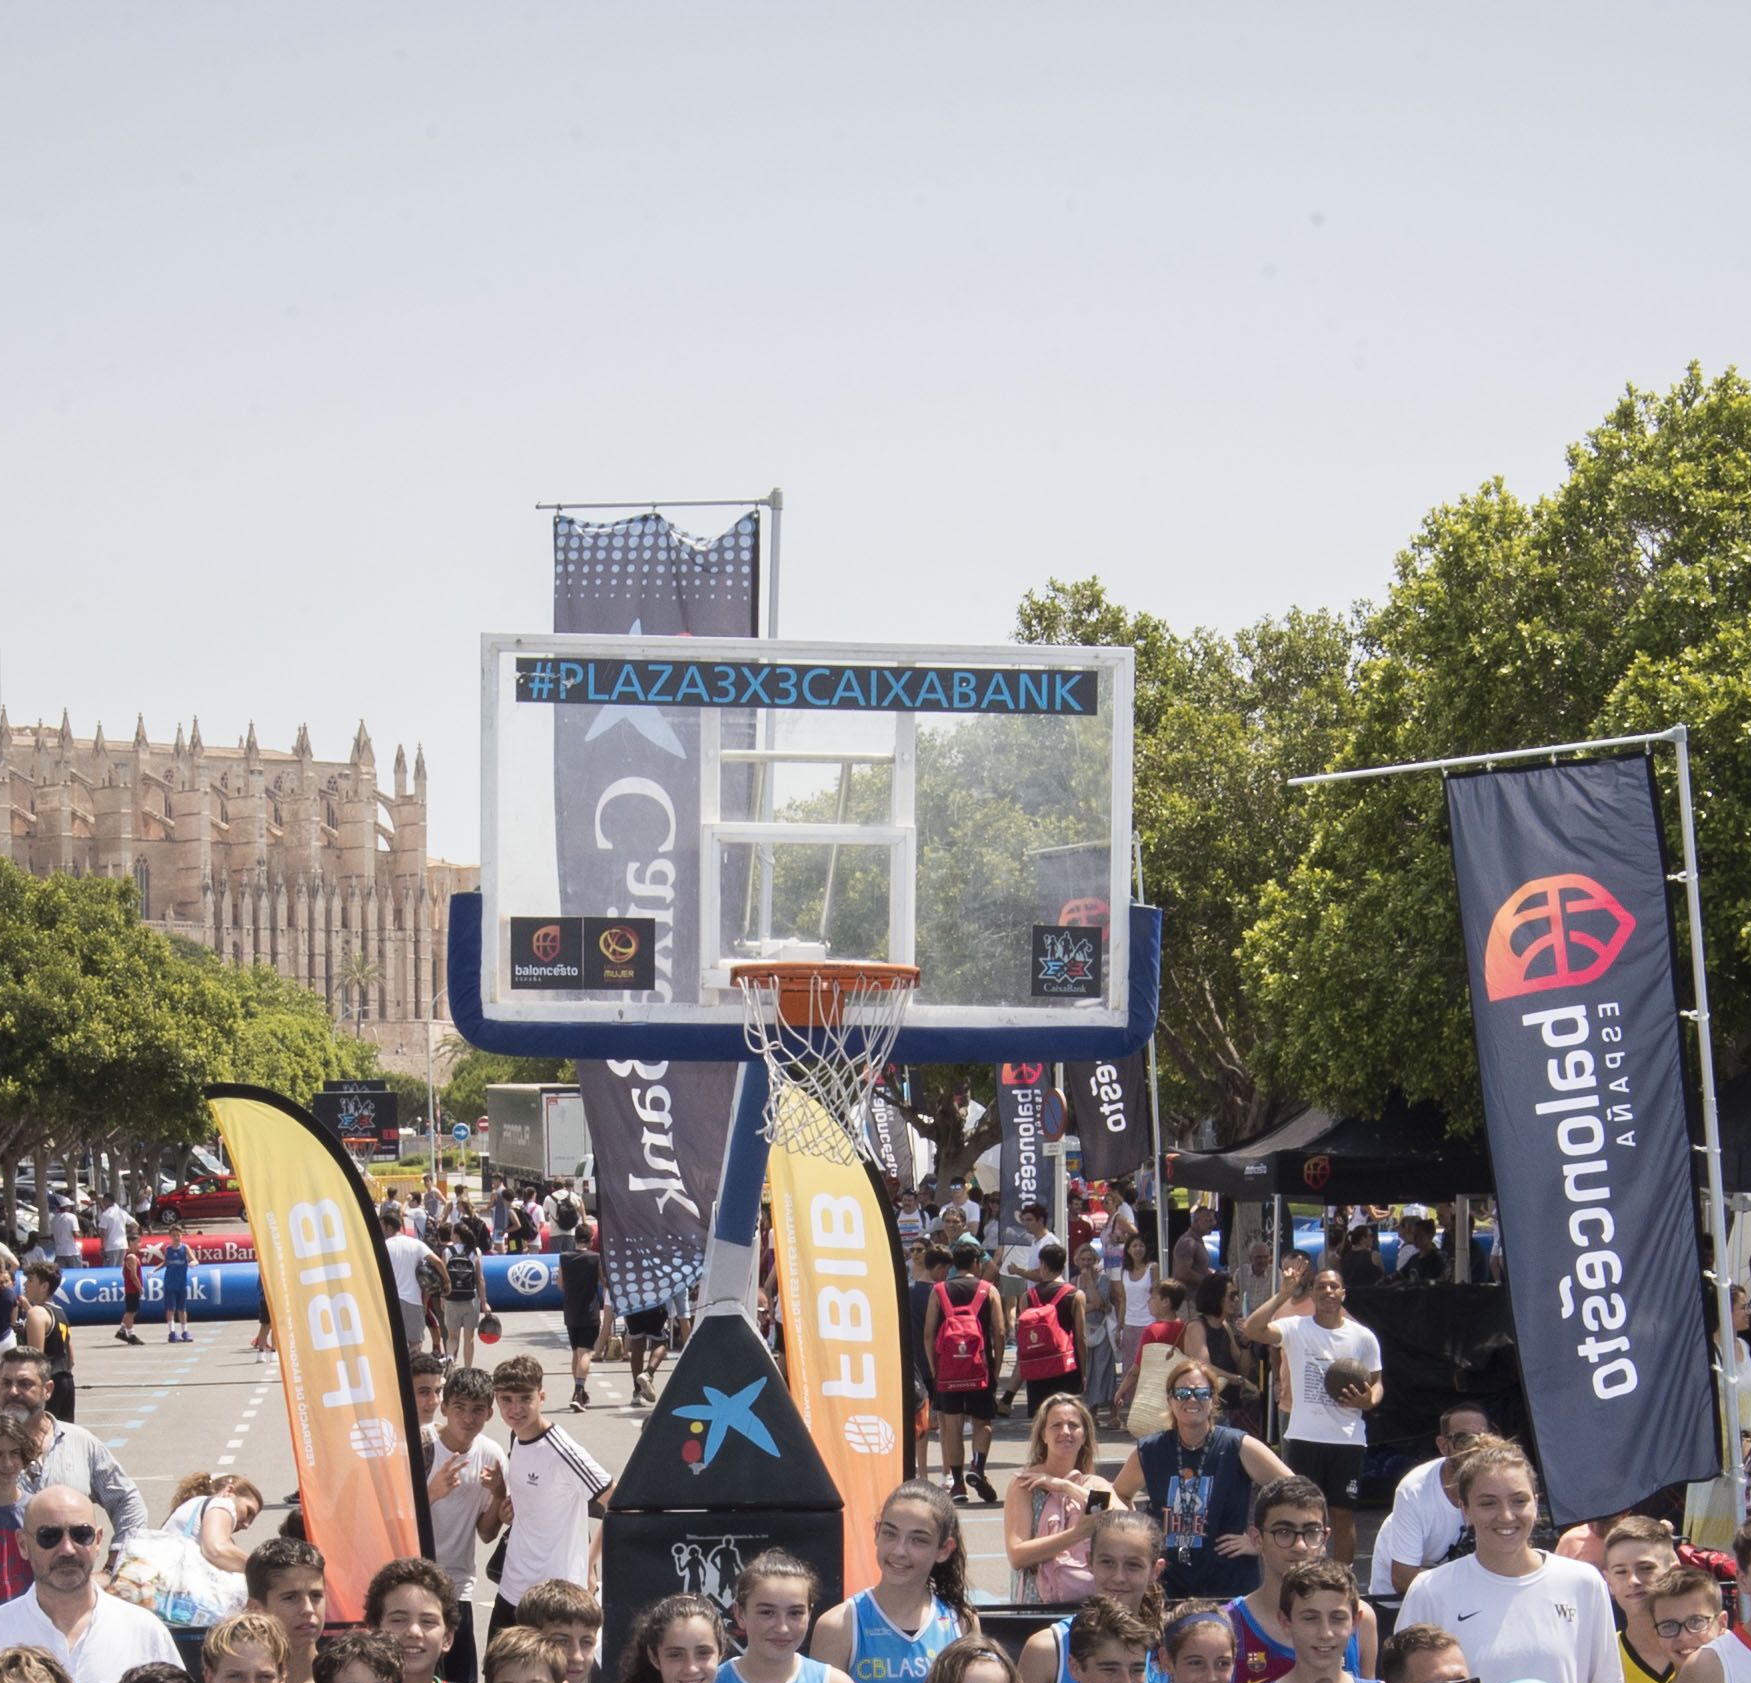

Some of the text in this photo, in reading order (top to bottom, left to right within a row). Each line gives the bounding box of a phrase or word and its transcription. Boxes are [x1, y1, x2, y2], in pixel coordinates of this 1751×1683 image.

[528, 660, 1084, 713] #PLAZA3X3CAIXABANK
[515, 963, 579, 977] baloncesto
[603, 969, 635, 978] MUJER
[1043, 983, 1087, 993] CaixaBank
